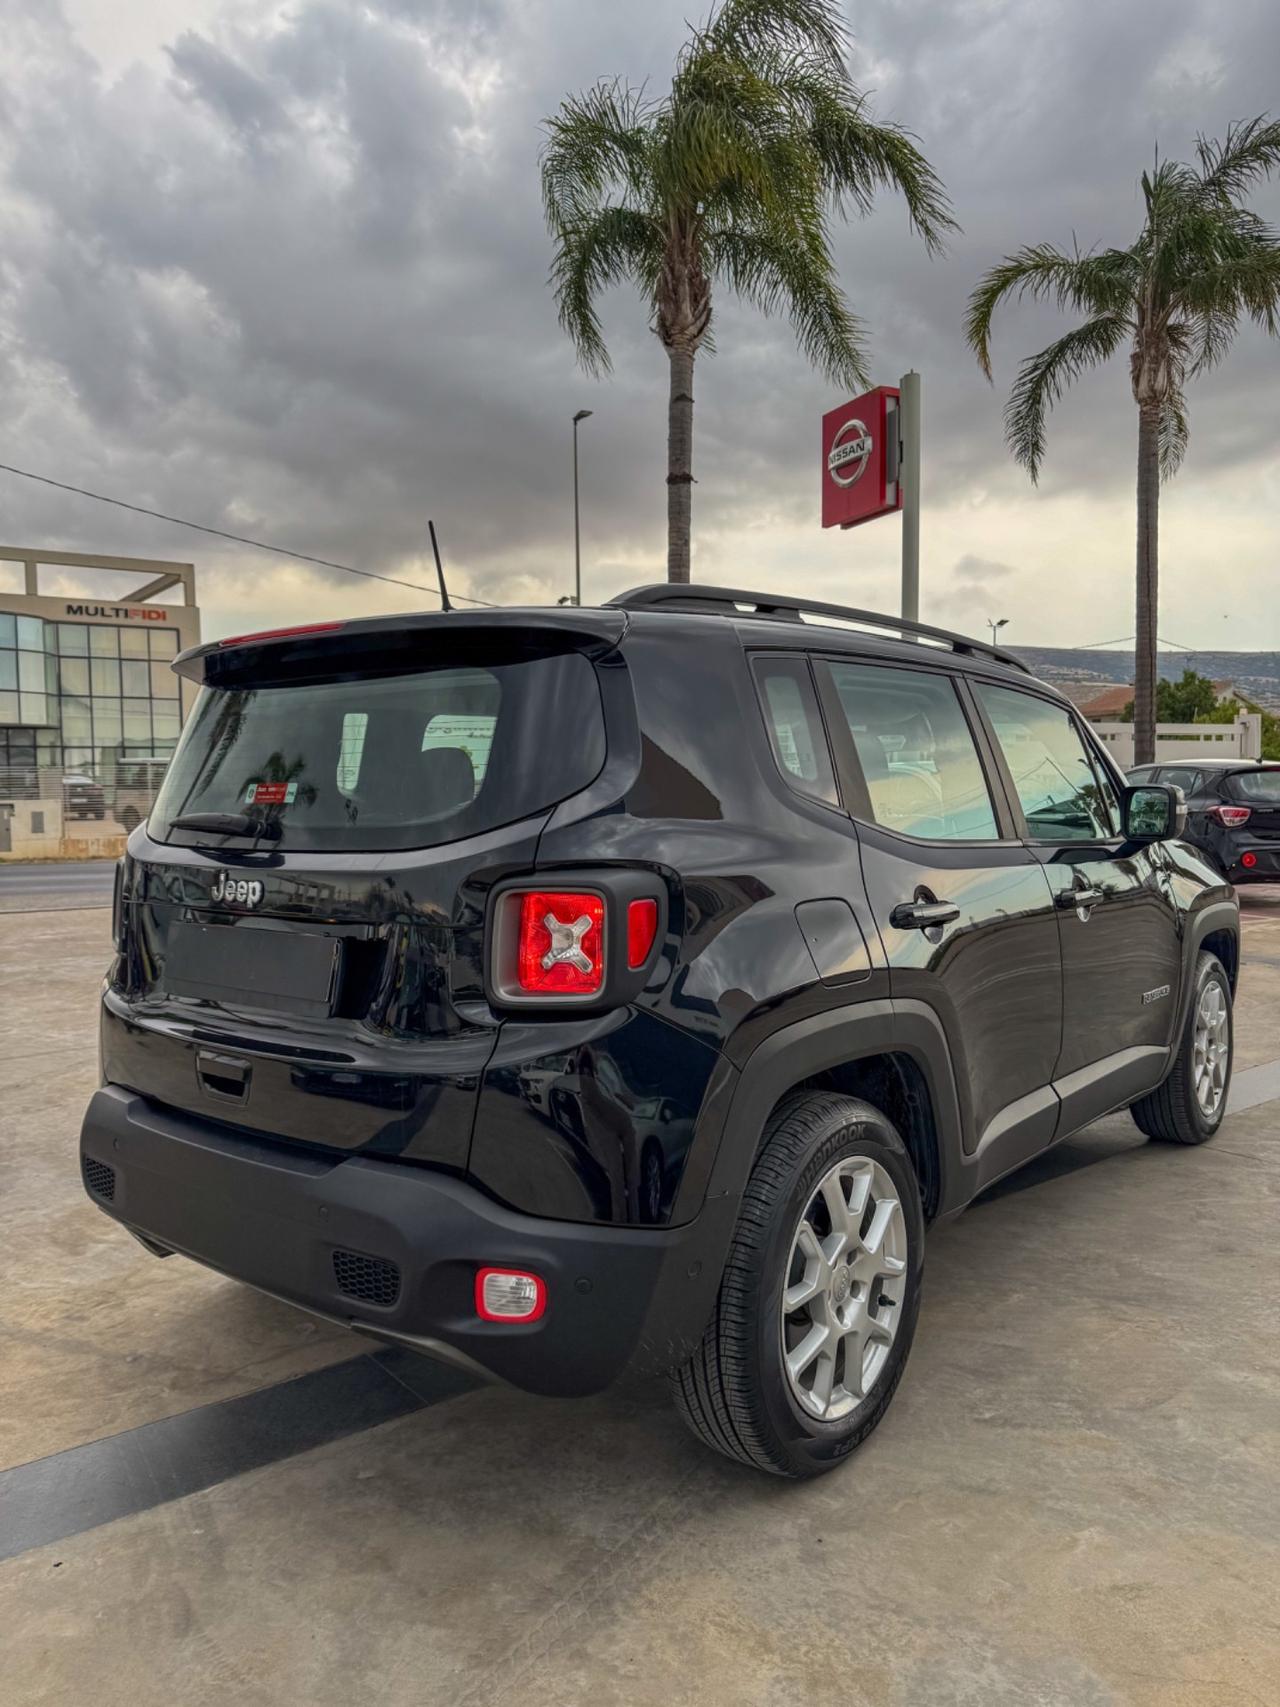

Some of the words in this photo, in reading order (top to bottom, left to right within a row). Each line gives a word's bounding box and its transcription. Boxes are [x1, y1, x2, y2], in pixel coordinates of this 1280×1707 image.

[830, 439, 865, 464] NISSAN
[66, 604, 167, 621] MULTIFIDI
[211, 873, 262, 908] Jeep
